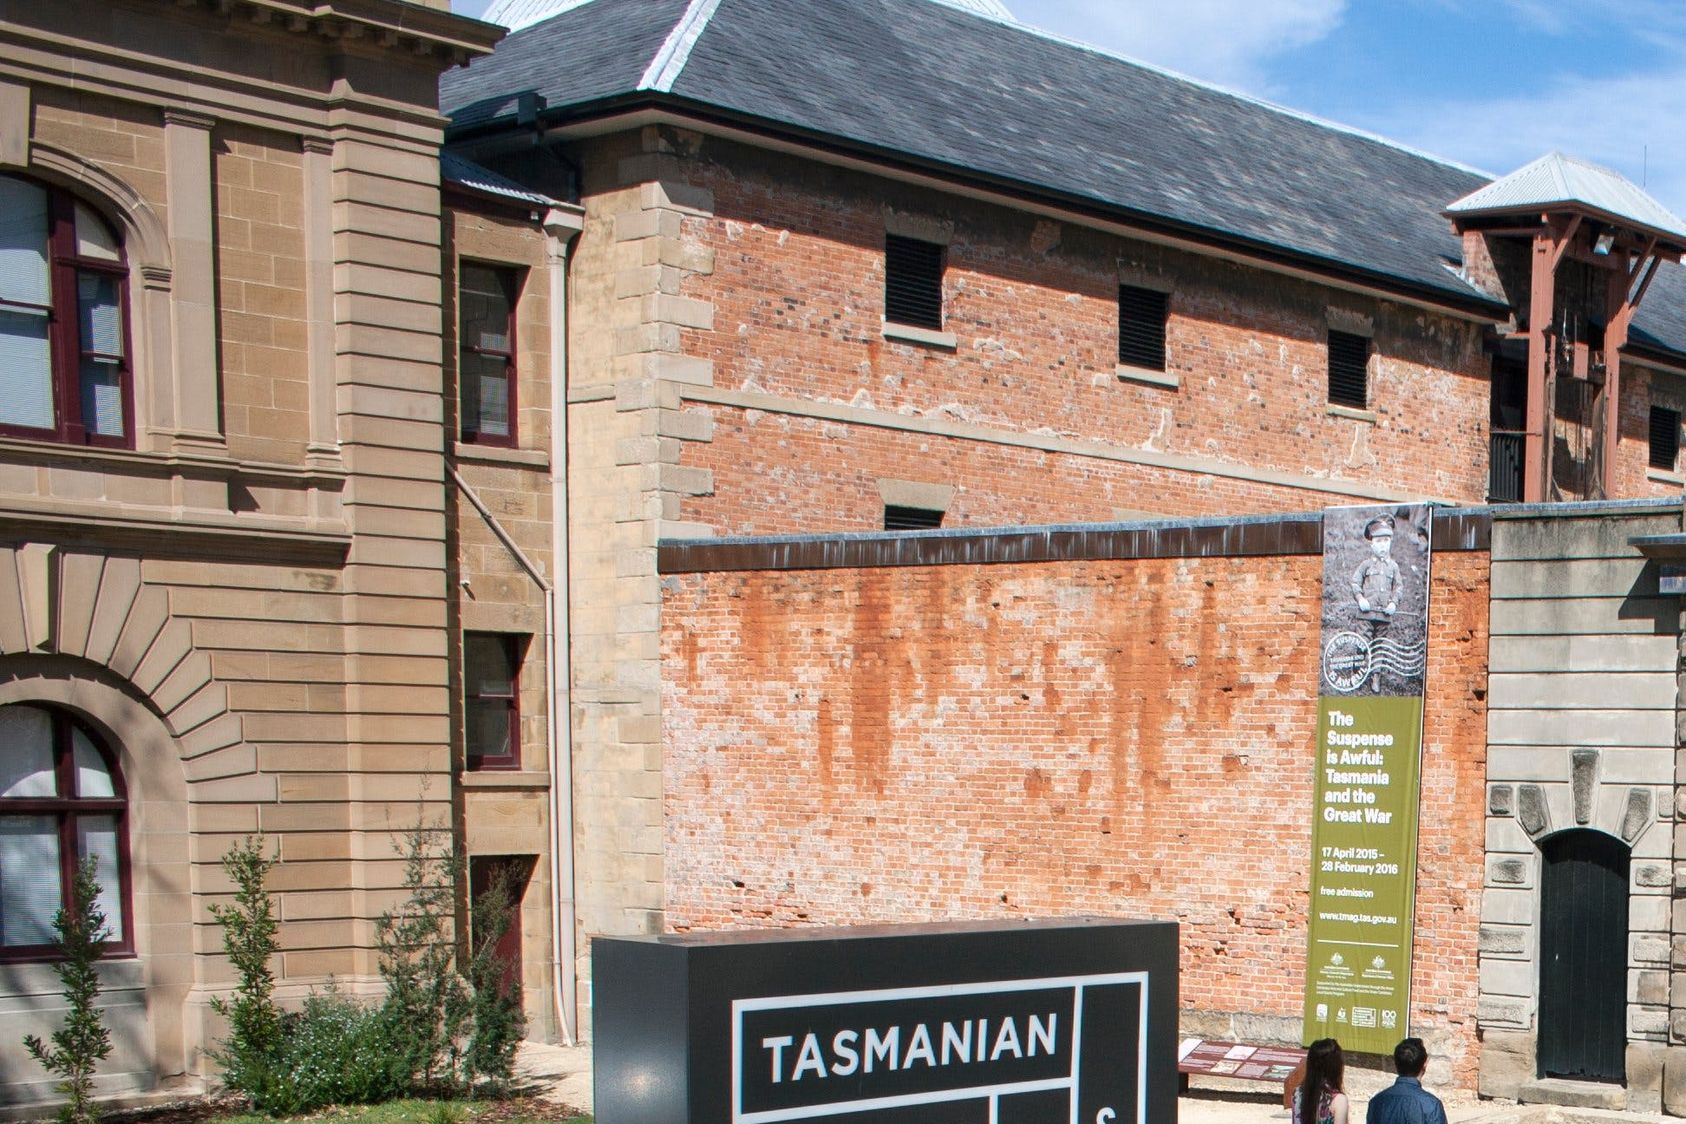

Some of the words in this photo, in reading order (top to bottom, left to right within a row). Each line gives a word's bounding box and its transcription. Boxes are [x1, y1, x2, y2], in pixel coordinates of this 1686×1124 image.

[1328, 710, 1354, 727] The
[1327, 730, 1394, 748] Suspense
[1326, 749, 1338, 764] is
[1340, 749, 1384, 766] Awful:
[1325, 768, 1390, 785] Tasmania
[1324, 788, 1351, 804] and
[1352, 788, 1376, 804] the
[1323, 806, 1363, 823] Great
[1364, 808, 1393, 825] War
[1321, 847, 1332, 857] 17
[1333, 848, 1355, 860] April
[1355, 849, 1378, 859] 2015
[1321, 861, 1333, 872] 28
[1334, 862, 1375, 875] February
[1375, 863, 1398, 875] 2016
[1320, 885, 1335, 896] free
[1336, 886, 1374, 898] admission
[1319, 911, 1397, 925] www.tmag.tas.gov.au
[762, 1012, 1058, 1084] TASMANIAN
